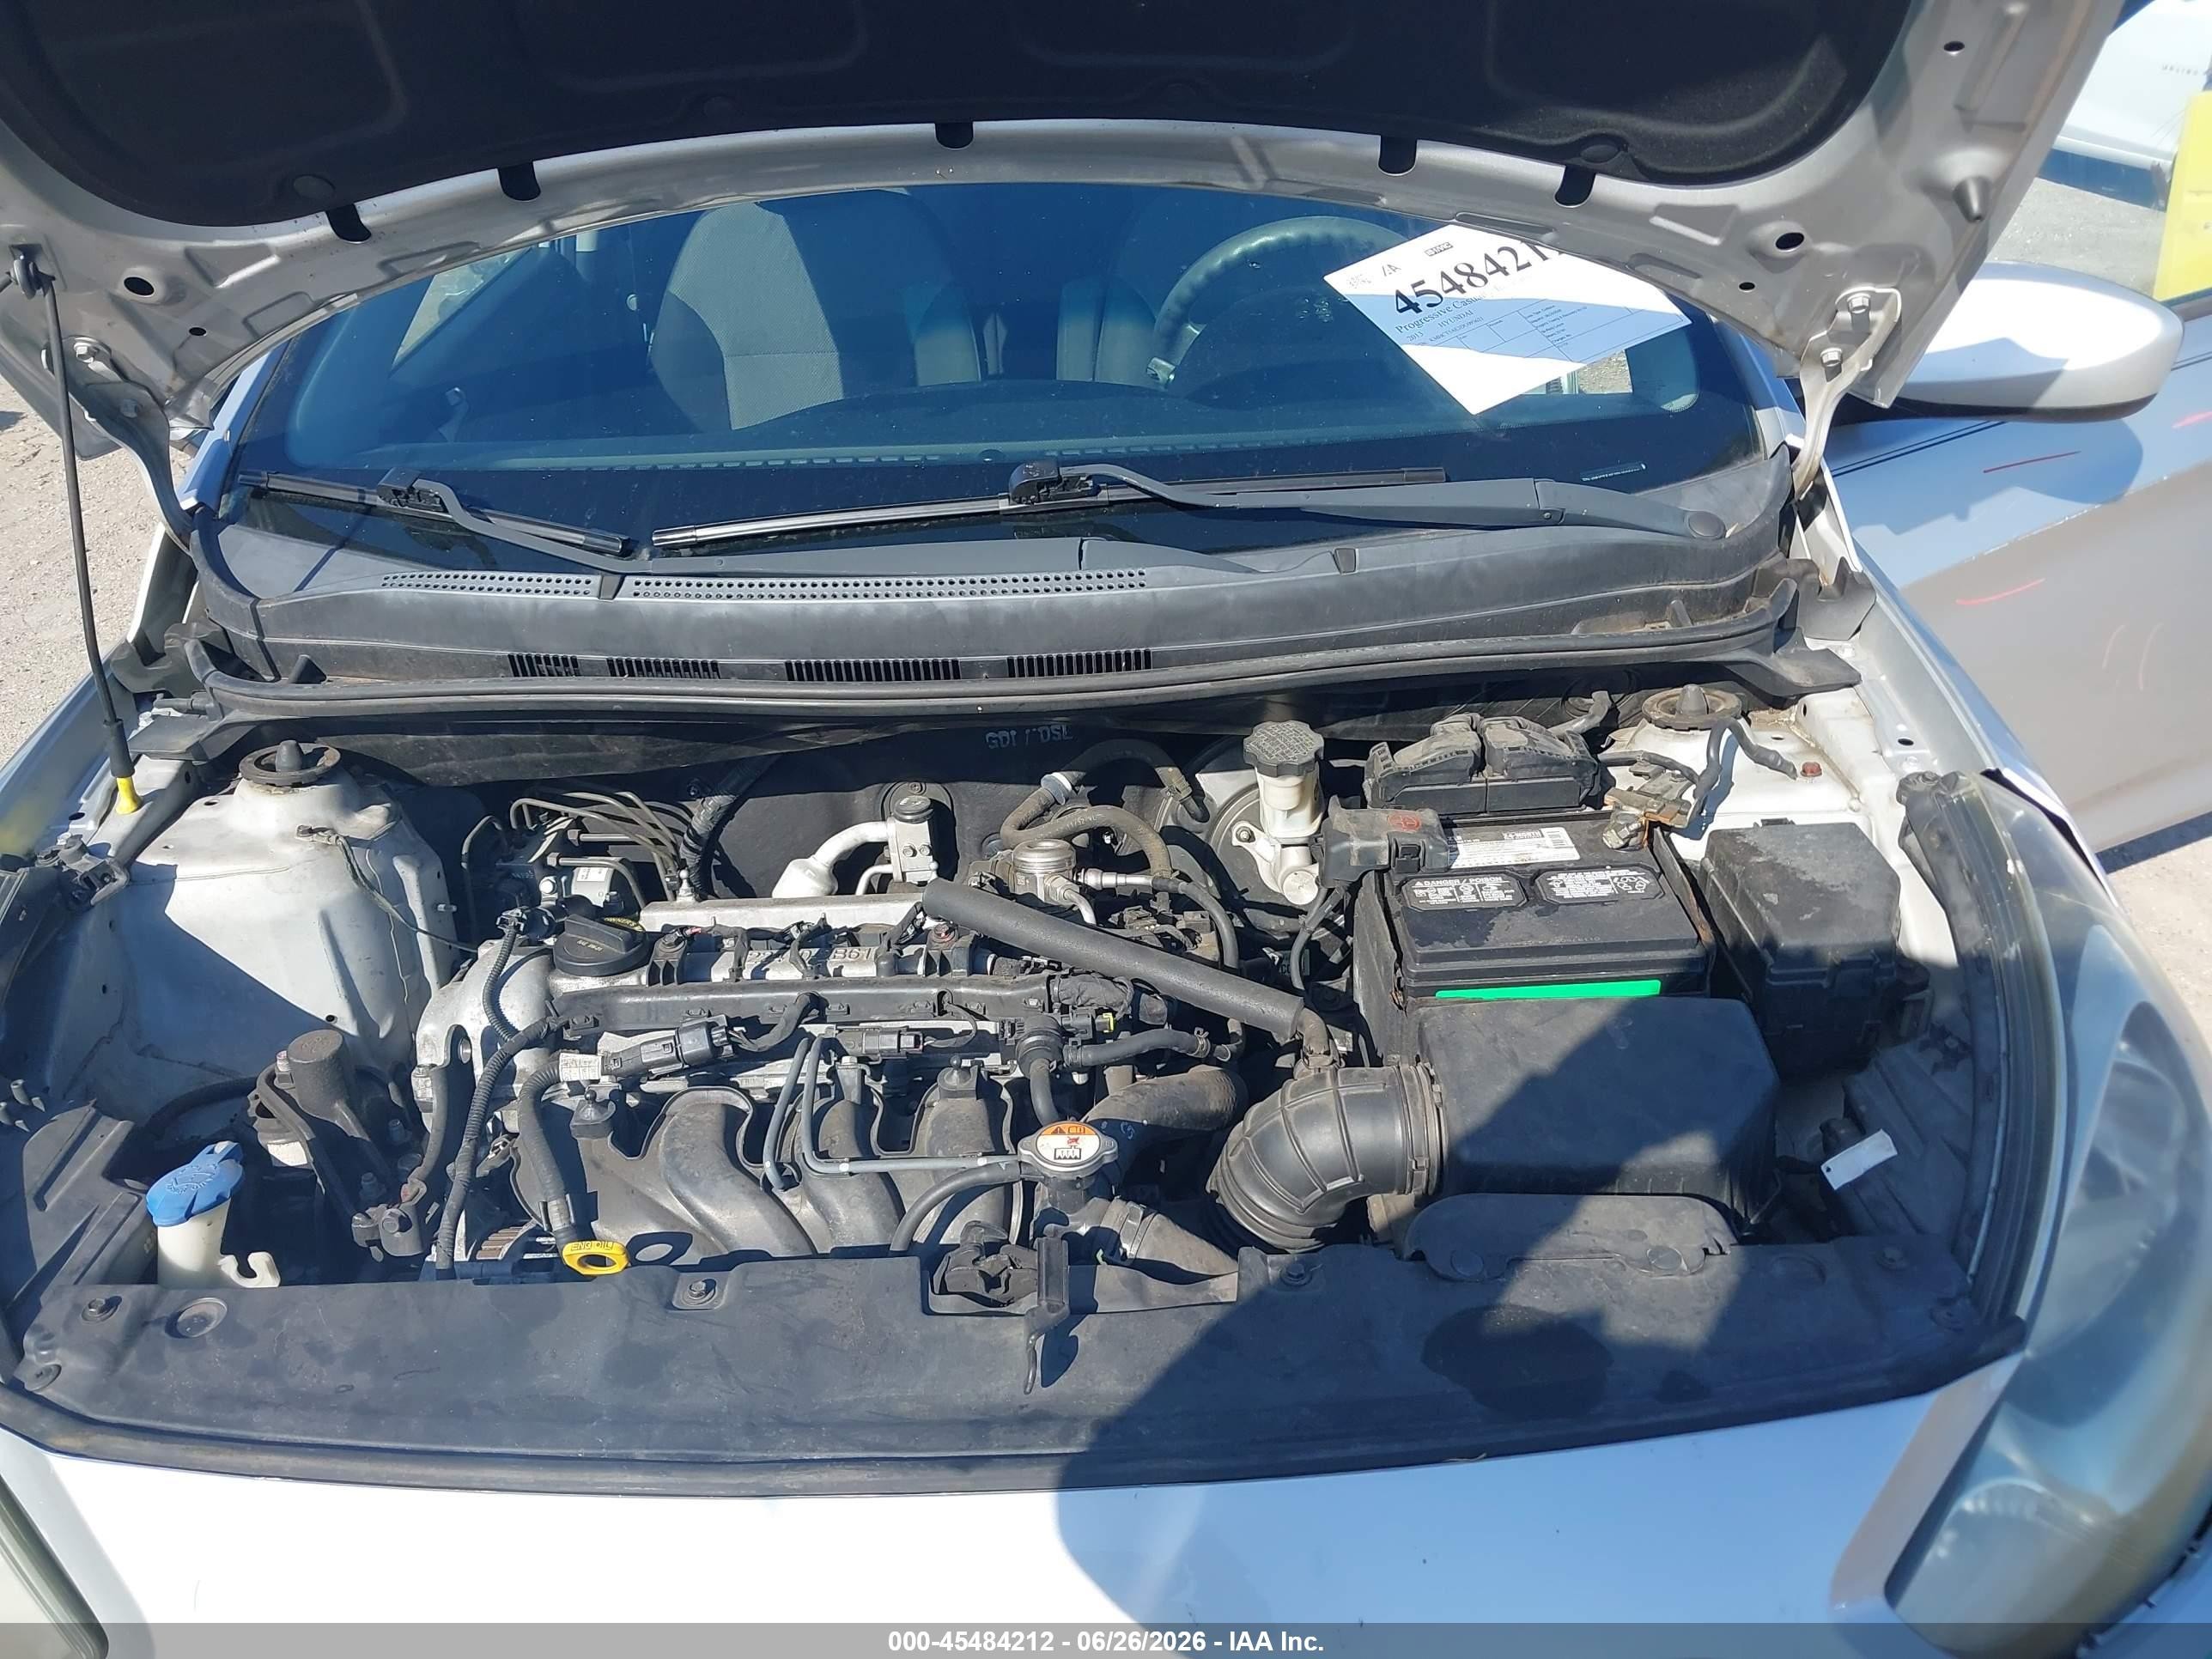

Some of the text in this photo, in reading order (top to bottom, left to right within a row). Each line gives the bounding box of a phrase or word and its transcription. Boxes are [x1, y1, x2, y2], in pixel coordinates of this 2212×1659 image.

[1395, 240, 1565, 313] 4548421
[1395, 306, 1453, 333] Progressive
[1437, 310, 1474, 327] HYUNDAI
[1407, 331, 1424, 343] 2013
[571, 1241, 613, 1251] ENG OIL
